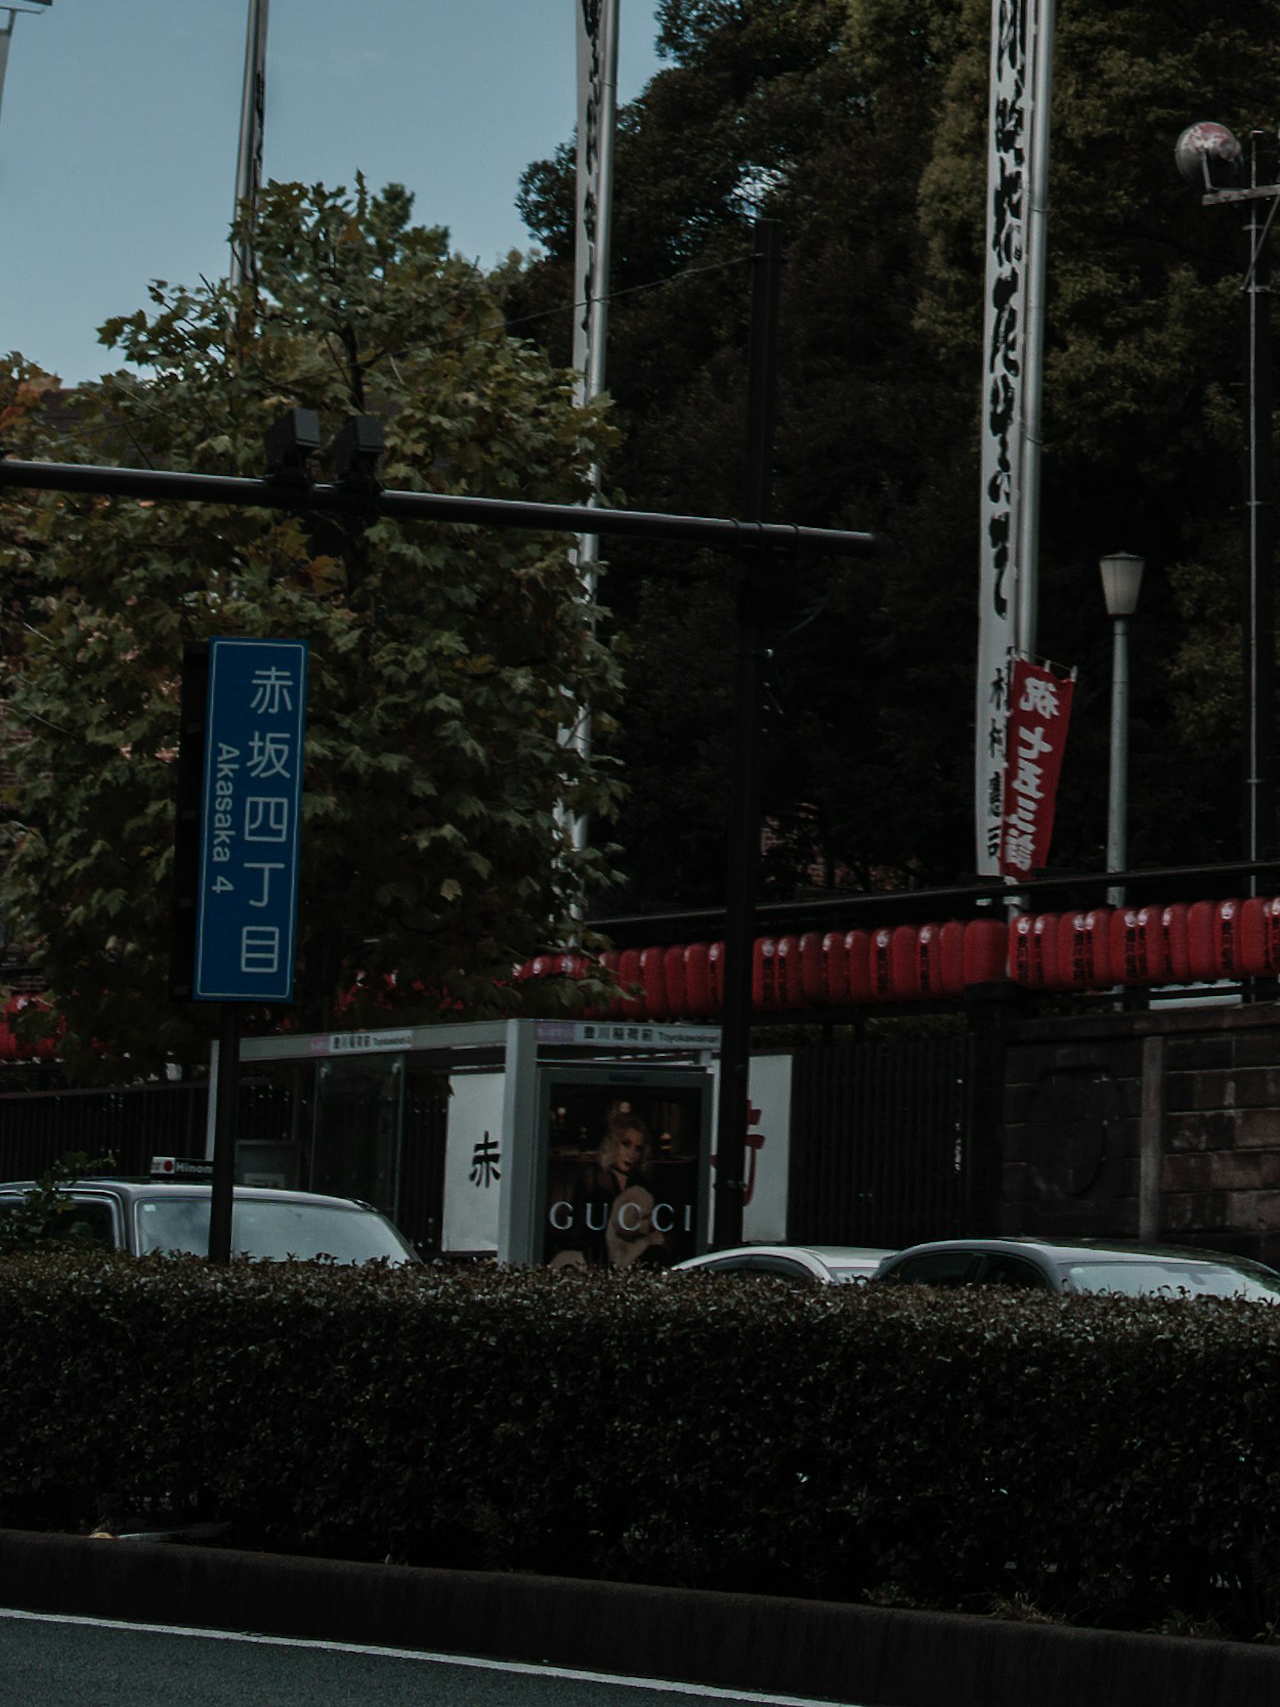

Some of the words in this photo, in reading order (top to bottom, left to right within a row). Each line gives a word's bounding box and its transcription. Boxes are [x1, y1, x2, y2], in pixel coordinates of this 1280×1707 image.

[211, 742, 241, 862] Akasaka
[240, 666, 294, 974] 赤坂四丁目
[211, 876, 235, 893] 4
[548, 1202, 697, 1233] GUCCI
